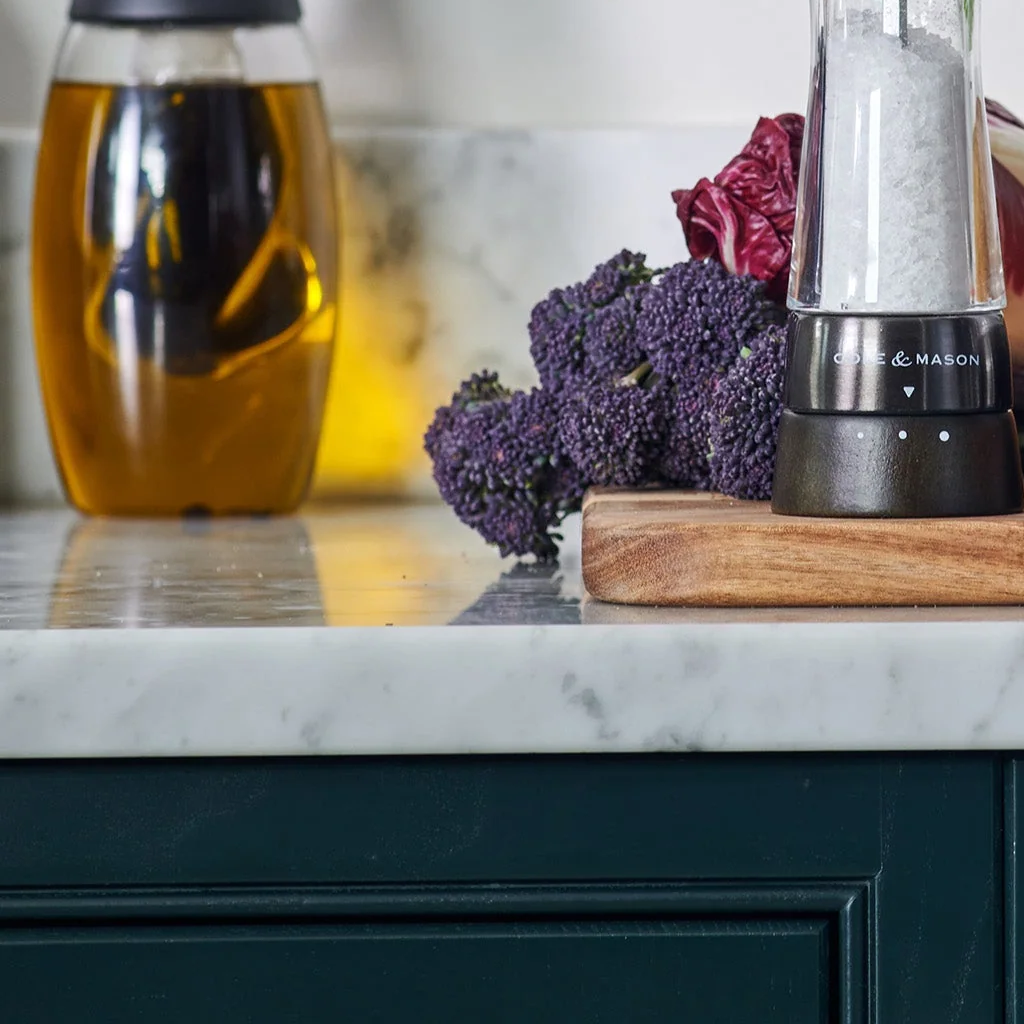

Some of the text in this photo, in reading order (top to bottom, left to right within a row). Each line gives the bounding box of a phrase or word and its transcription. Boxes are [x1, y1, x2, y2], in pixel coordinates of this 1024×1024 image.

[833, 350, 980, 367] COE & MASON
